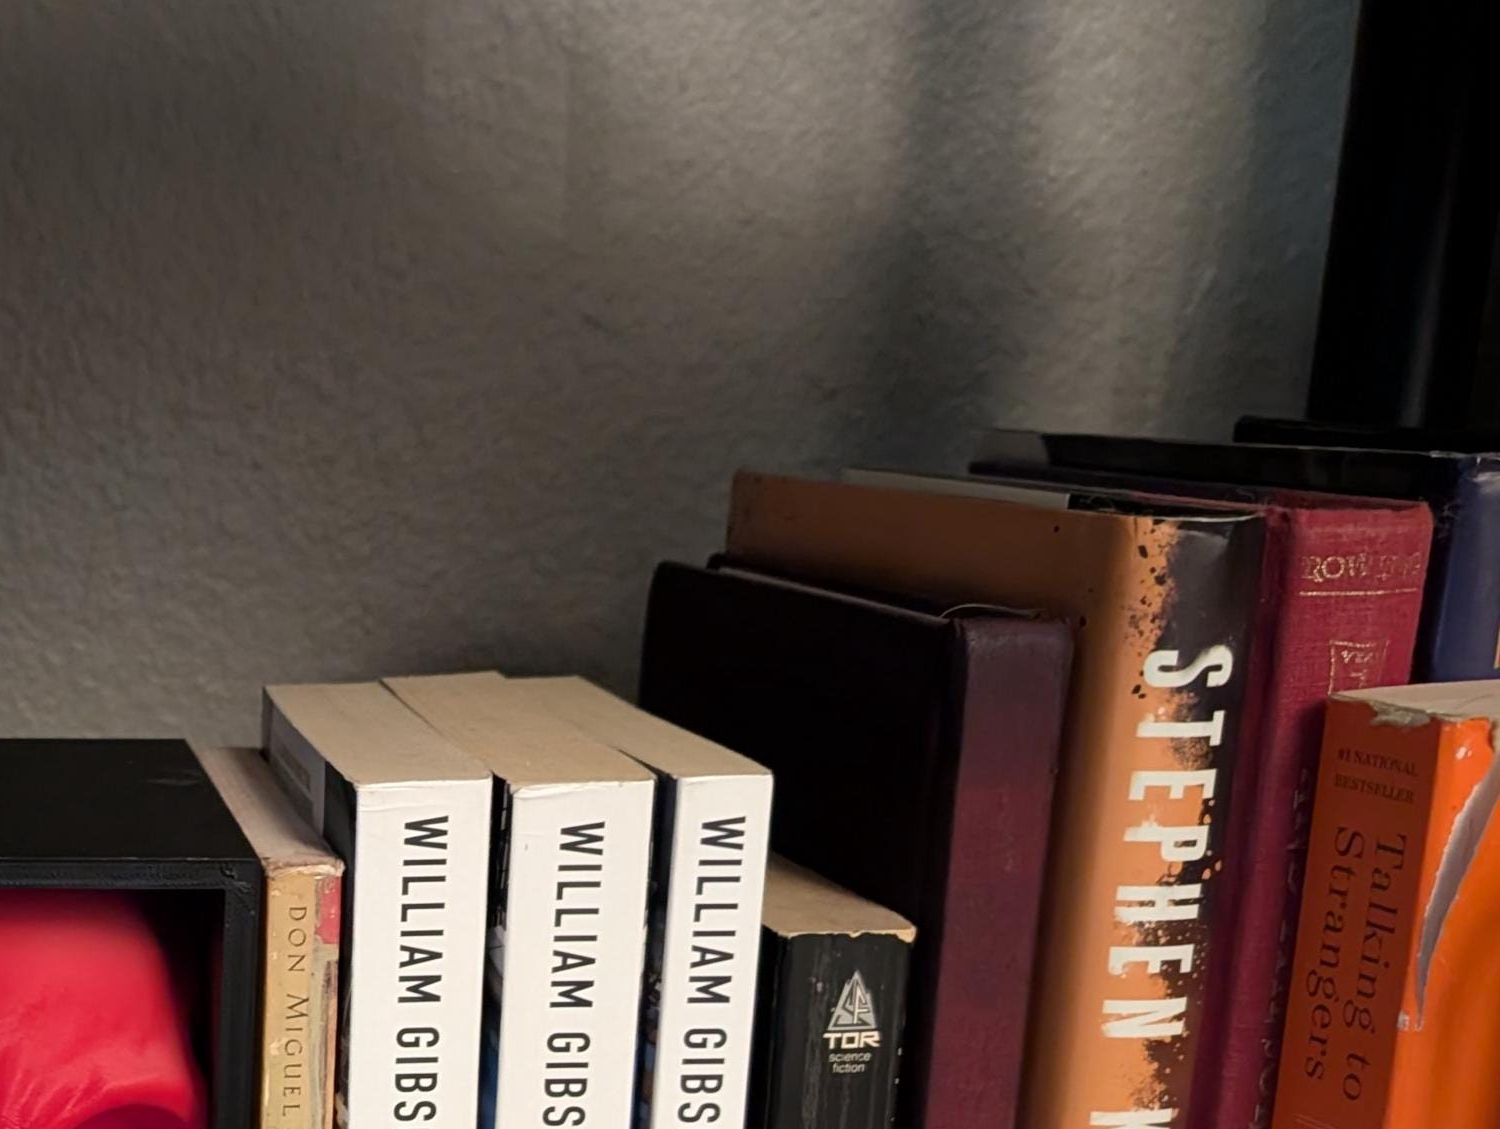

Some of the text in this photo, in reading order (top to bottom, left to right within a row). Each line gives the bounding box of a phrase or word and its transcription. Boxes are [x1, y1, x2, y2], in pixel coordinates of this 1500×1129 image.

[1333, 773, 1415, 804] BESTSELLER
[1353, 749, 1419, 777] NATIONAL
[1101, 644, 1233, 1039] STEPHEN
[287, 905, 307, 973] DON
[397, 815, 449, 1004] WILLIAM
[550, 821, 605, 1009] WILLIAM
[687, 815, 746, 1004] WILLIAM
[1305, 826, 1365, 1081] Strangers
[1342, 834, 1408, 1101] Talking to
[281, 993, 309, 1117] MIGUEL
[823, 1031, 880, 1050] TOR
[828, 1052, 872, 1062] science
[832, 1062, 866, 1073] fiction
